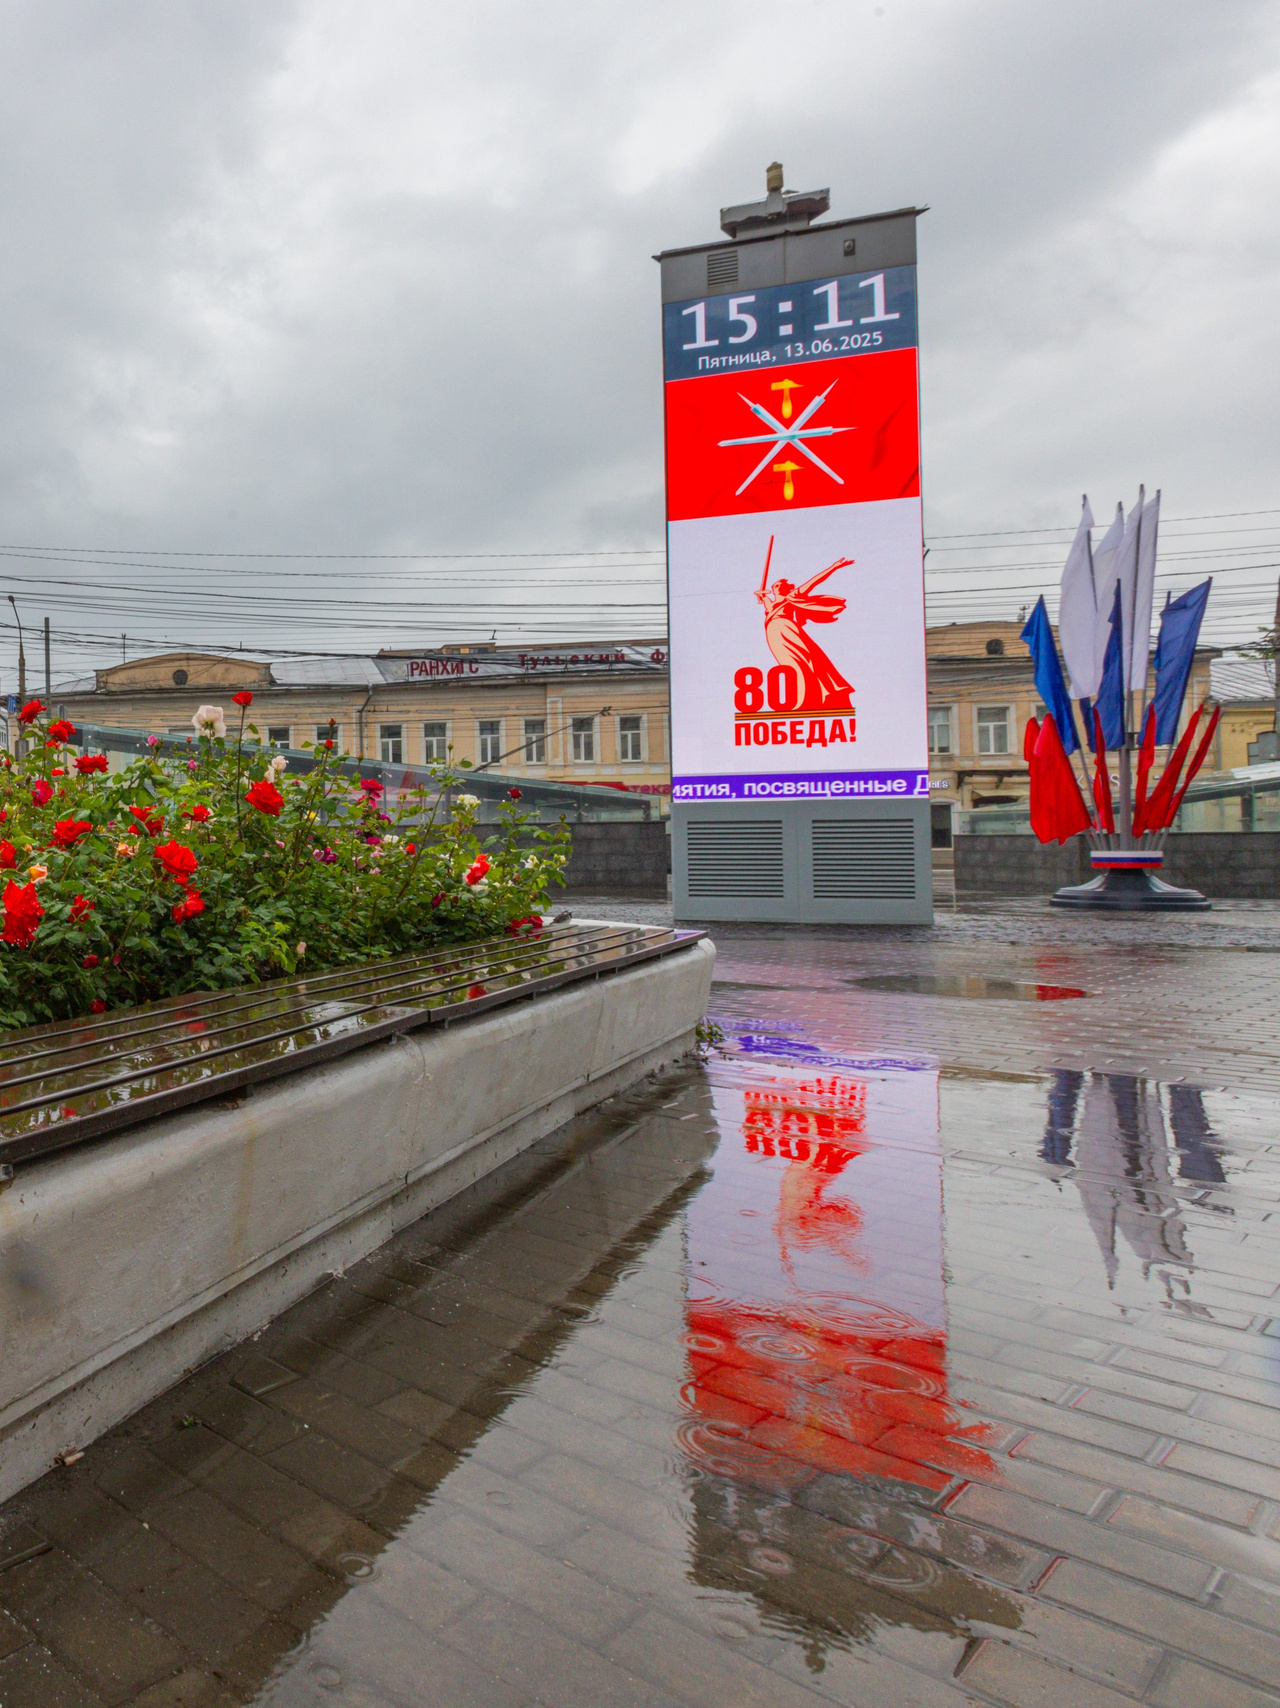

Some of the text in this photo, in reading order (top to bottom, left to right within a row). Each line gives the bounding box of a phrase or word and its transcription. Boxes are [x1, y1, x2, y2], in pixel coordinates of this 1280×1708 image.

[698, 331, 883, 370] Пятница, 13.06.2025
[650, 648, 668, 665] Ф
[734, 665, 799, 713] 80
[734, 718, 857, 748] ПОБЕДА!
[627, 783, 671, 795] тека
[743, 777, 907, 796] посвященные
